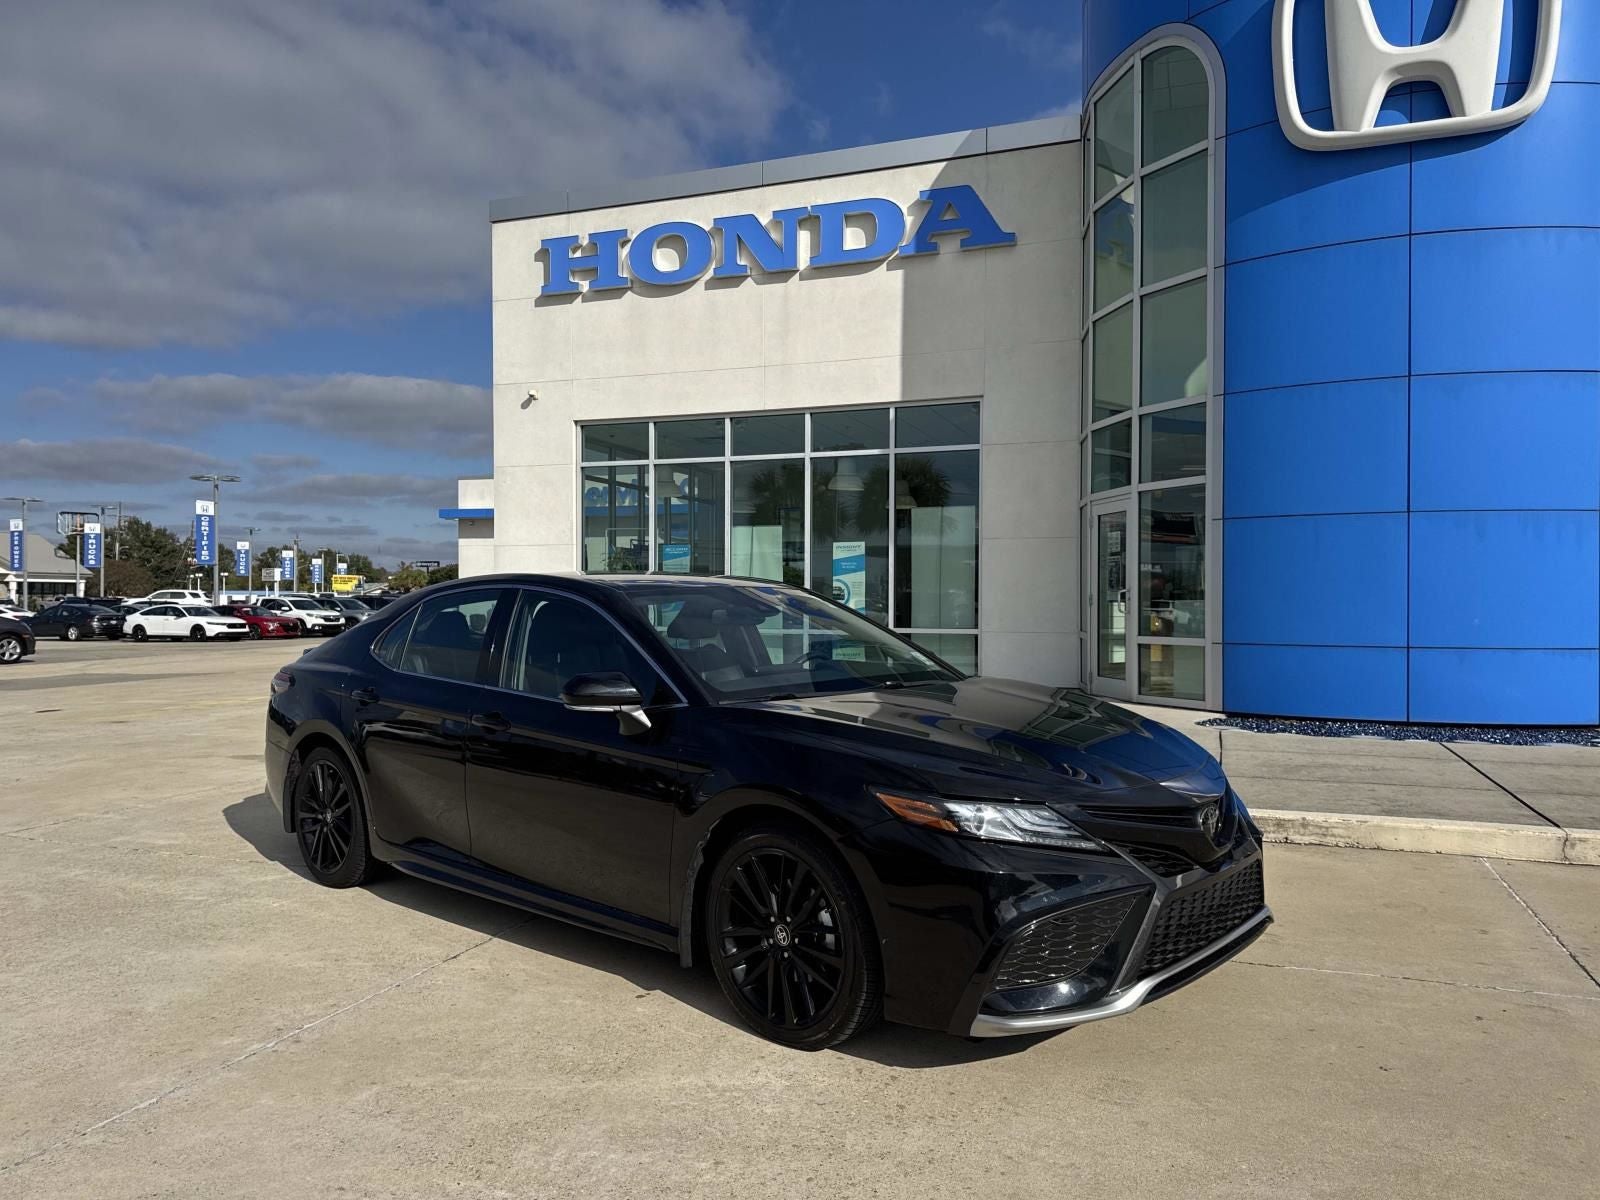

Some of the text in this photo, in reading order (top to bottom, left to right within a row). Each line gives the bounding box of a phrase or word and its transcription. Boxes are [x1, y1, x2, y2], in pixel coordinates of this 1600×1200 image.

[540, 184, 1016, 296] HONDA
[88, 534, 96, 565] TRUCKS
[200, 516, 210, 561] CERTIFIED
